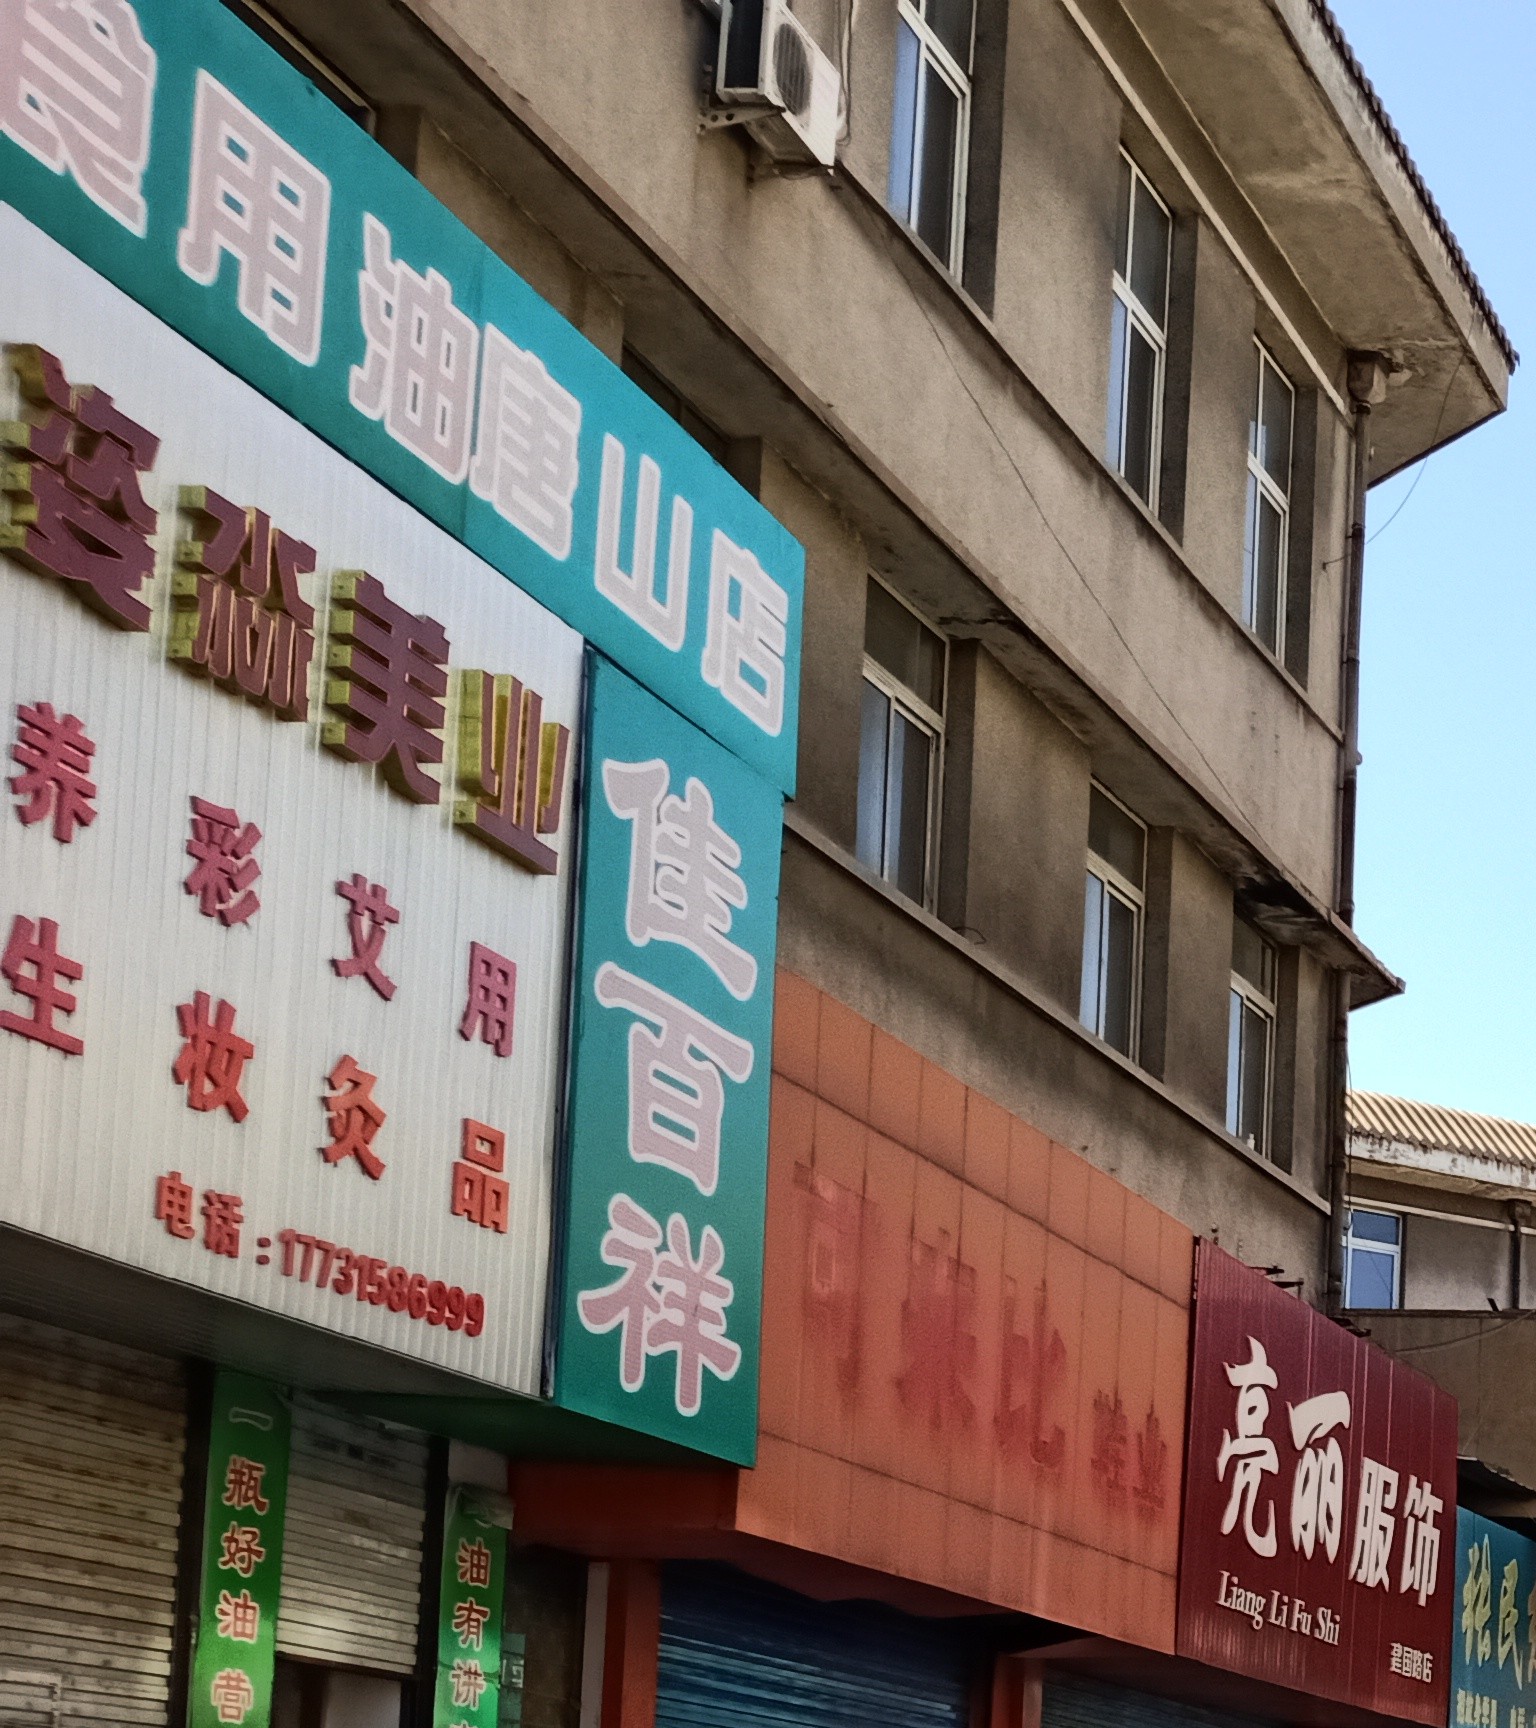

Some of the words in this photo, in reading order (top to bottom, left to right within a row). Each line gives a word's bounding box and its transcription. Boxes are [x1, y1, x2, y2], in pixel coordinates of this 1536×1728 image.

[577, 758, 758, 1417] 佳百祥
[215, 1407, 273, 1643] 一瓶好油
[1217, 1336, 1443, 1606] 亮丽服饰
[1218, 1571, 1265, 1629] Liang
[1269, 1591, 1288, 1628] Li
[1290, 1598, 1313, 1636] Fu
[1315, 1607, 1341, 1646] Shi
[1390, 1641, 1433, 1684] 建国路店
